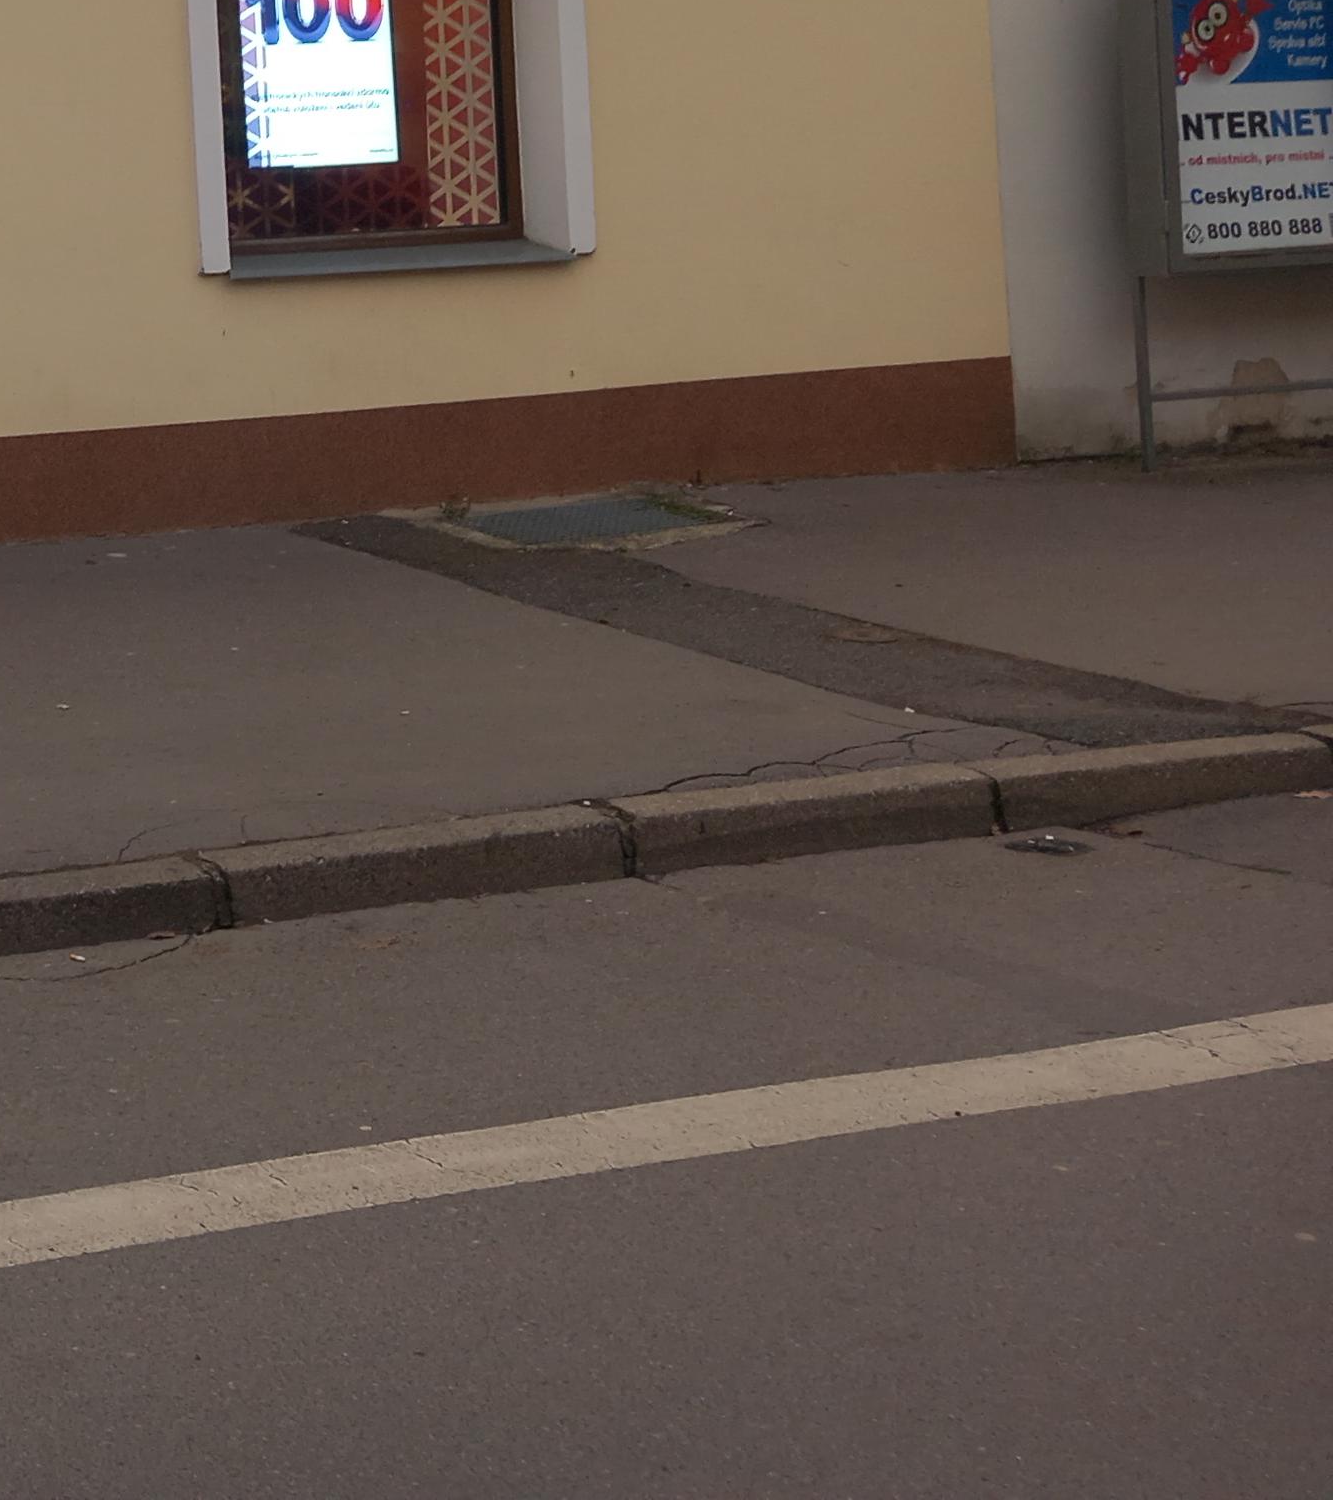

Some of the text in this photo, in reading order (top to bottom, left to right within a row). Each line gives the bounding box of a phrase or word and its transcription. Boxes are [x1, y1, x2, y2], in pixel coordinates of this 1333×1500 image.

[1181, 107, 1332, 141] NTERNET
[1188, 153, 1203, 165] od
[1265, 153, 1286, 167] pro
[1207, 218, 1323, 240] 800 880 888
